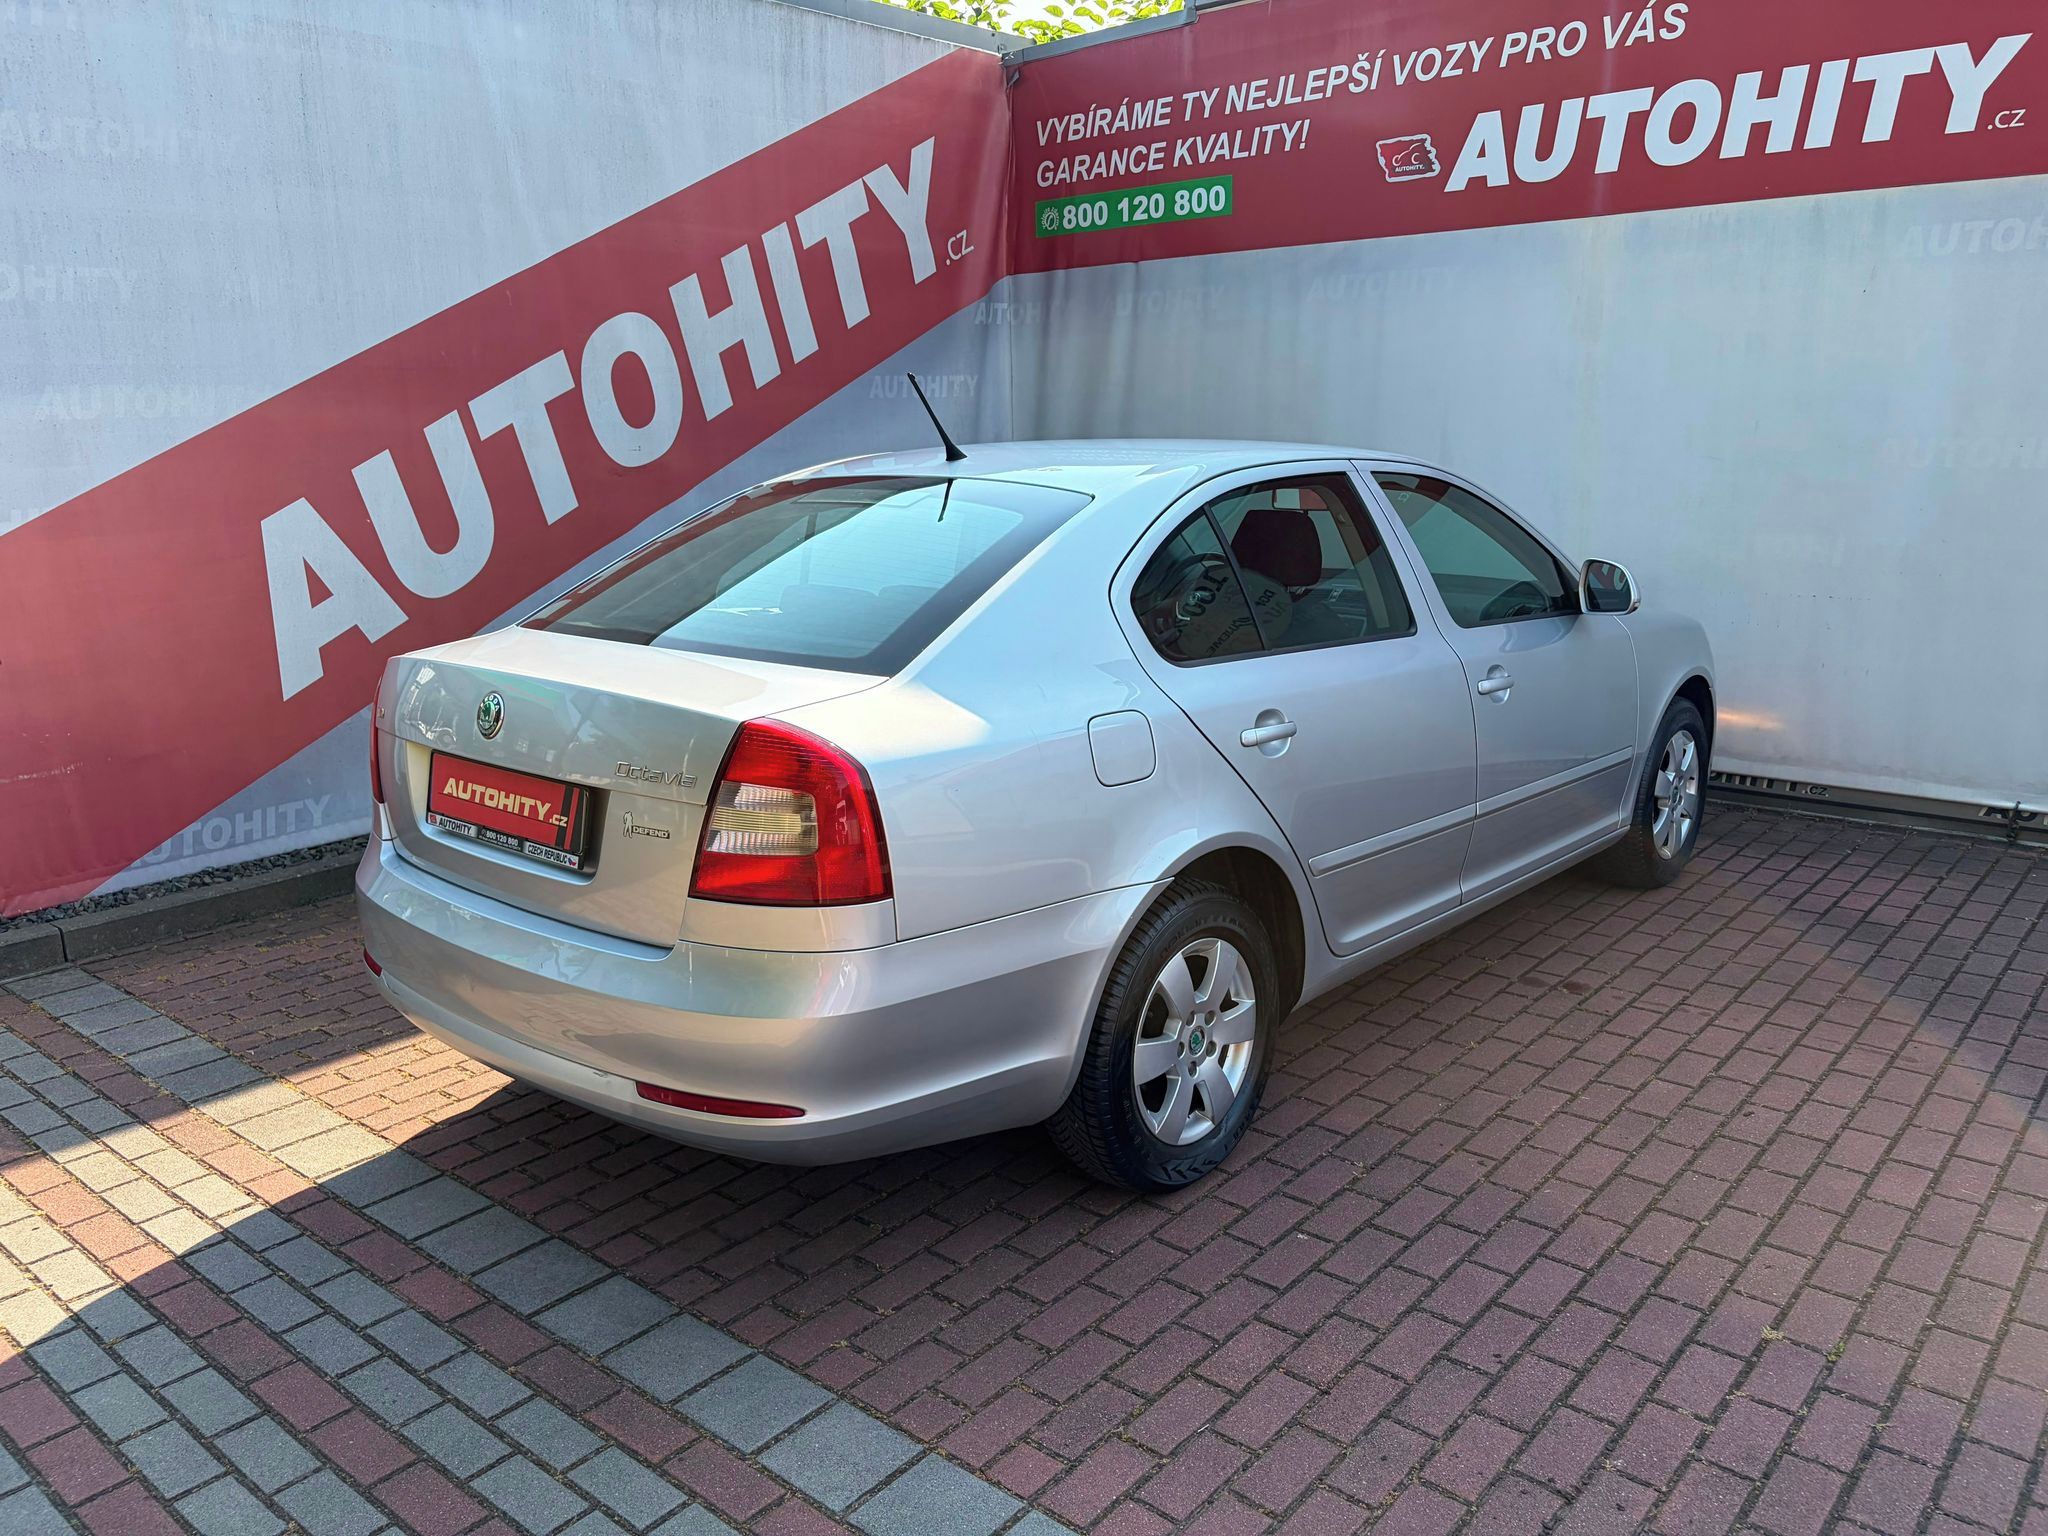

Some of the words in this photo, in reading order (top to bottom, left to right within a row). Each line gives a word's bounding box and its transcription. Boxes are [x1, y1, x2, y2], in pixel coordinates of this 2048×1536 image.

[1036, 97, 1174, 146] VYBÍRÁME
[1182, 87, 1220, 121] TY
[1224, 49, 1387, 115] NEJLEPŠÍ
[1393, 36, 1495, 86] VOZY
[1499, 20, 1588, 68] PRO
[1602, 1, 1689, 50] VÁS
[1036, 141, 1167, 188] GARANCE
[1173, 119, 1311, 168] KVALITY!
[1062, 200, 1109, 230] 800
[1117, 193, 1165, 222] 120
[1174, 185, 1226, 216] 800
[615, 761, 698, 789] Octavia
[632, 825, 669, 838] DEFEND
[527, 844, 543, 857] CZECH
[543, 848, 568, 865] REPUBLIC
